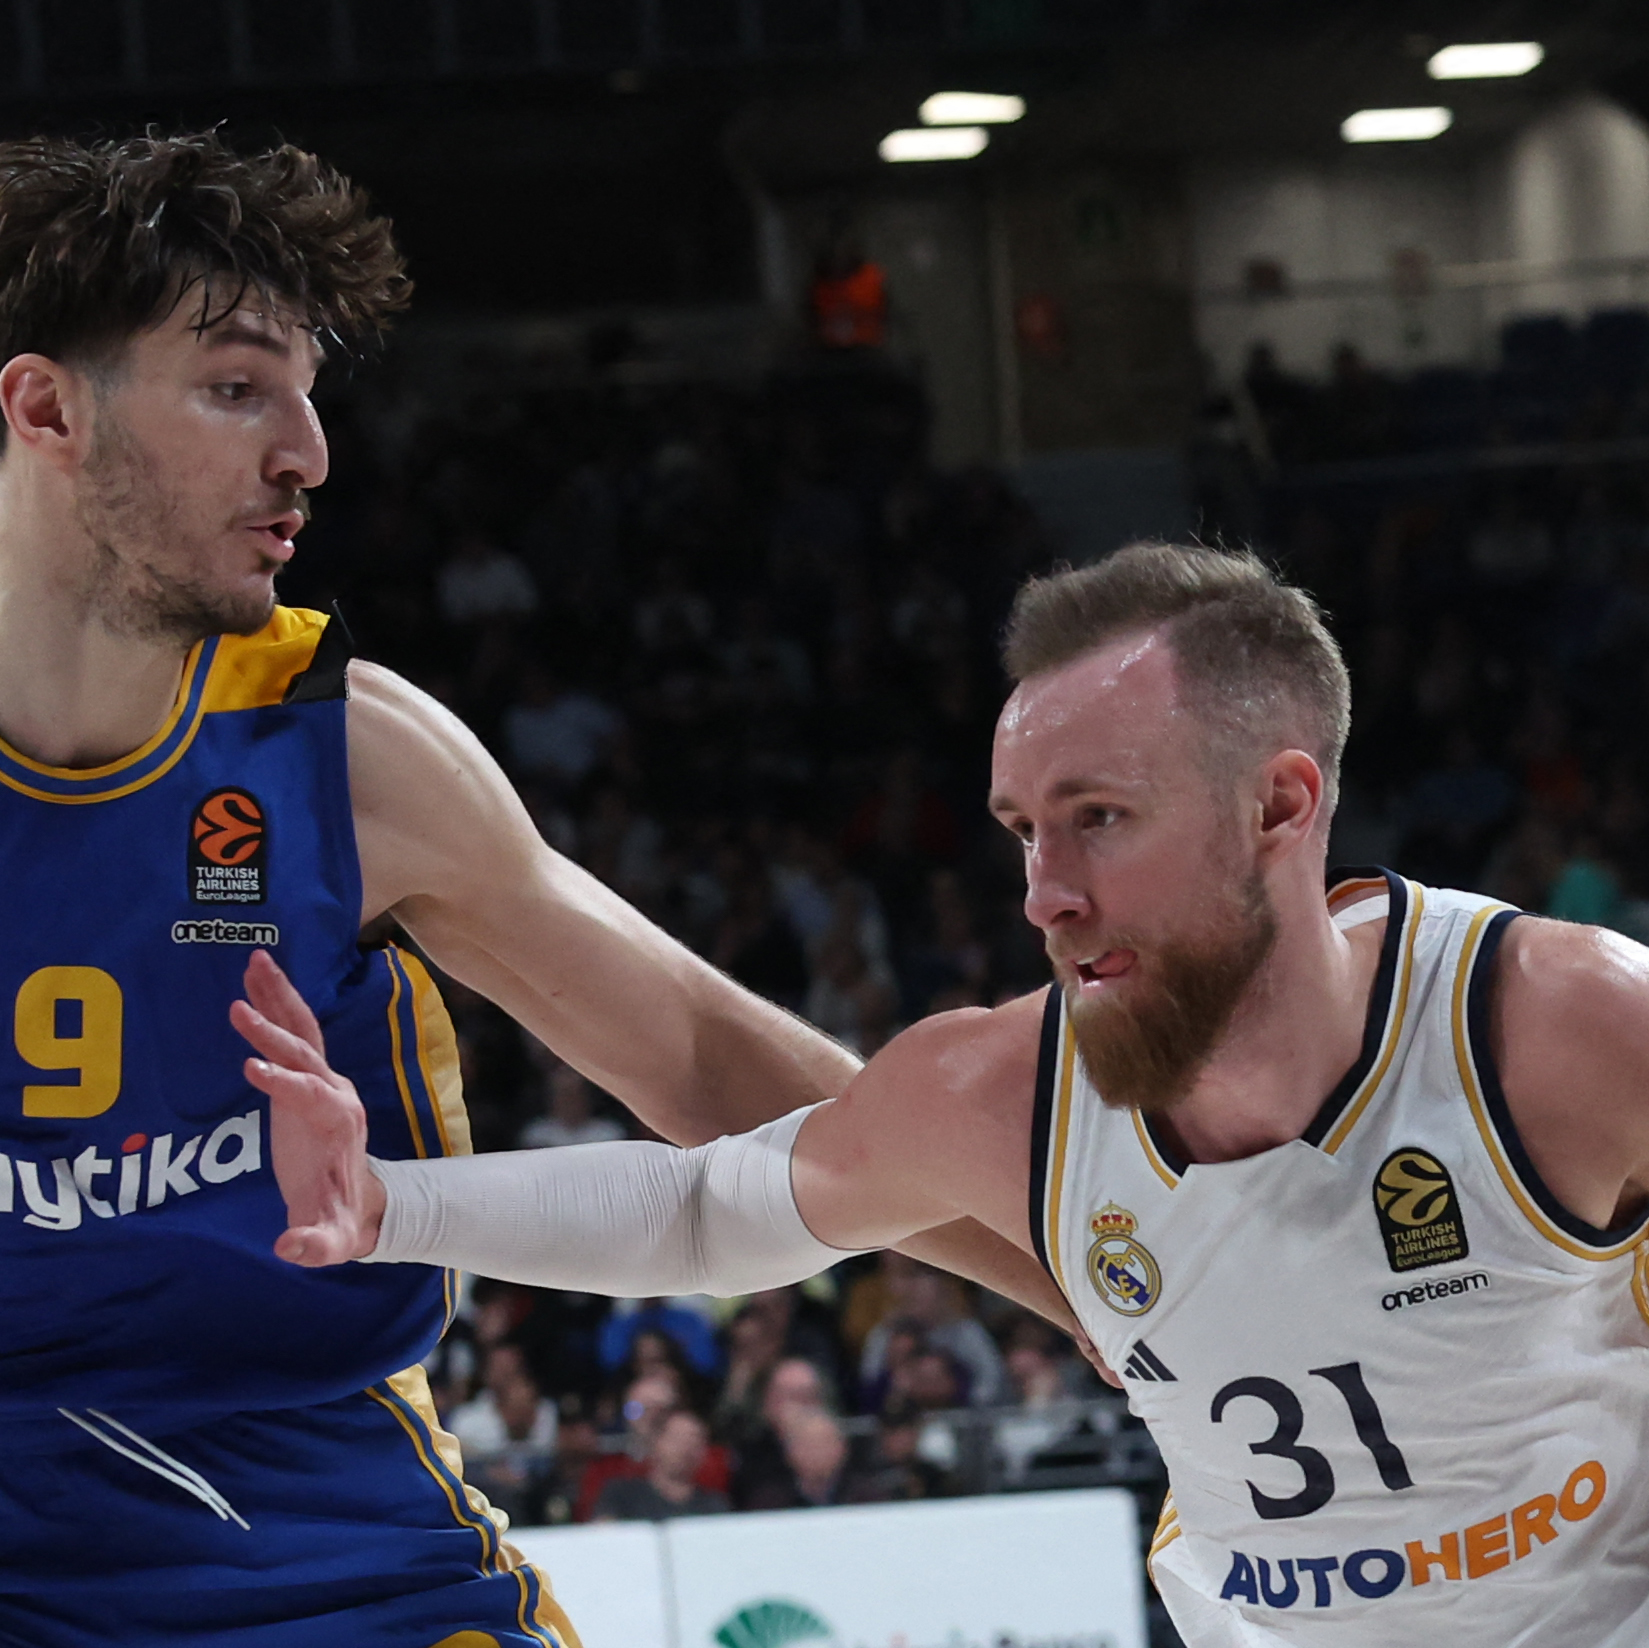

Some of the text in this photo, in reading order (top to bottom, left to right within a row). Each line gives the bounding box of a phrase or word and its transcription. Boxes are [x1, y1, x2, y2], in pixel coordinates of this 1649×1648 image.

[195, 866, 259, 880] TURKISH
[195, 879, 260, 891] AIRLINES
[195, 890, 261, 903] EuroLeague
[173, 919, 278, 945] oneteam
[13, 965, 124, 1119] 9
[1391, 1220, 1457, 1245] TURKISH
[1395, 1233, 1460, 1256] AIRLINES
[1380, 1272, 1490, 1312] oneteam
[1209, 1360, 1416, 1521] 31
[1220, 1458, 1608, 1610] AUTOHERO
